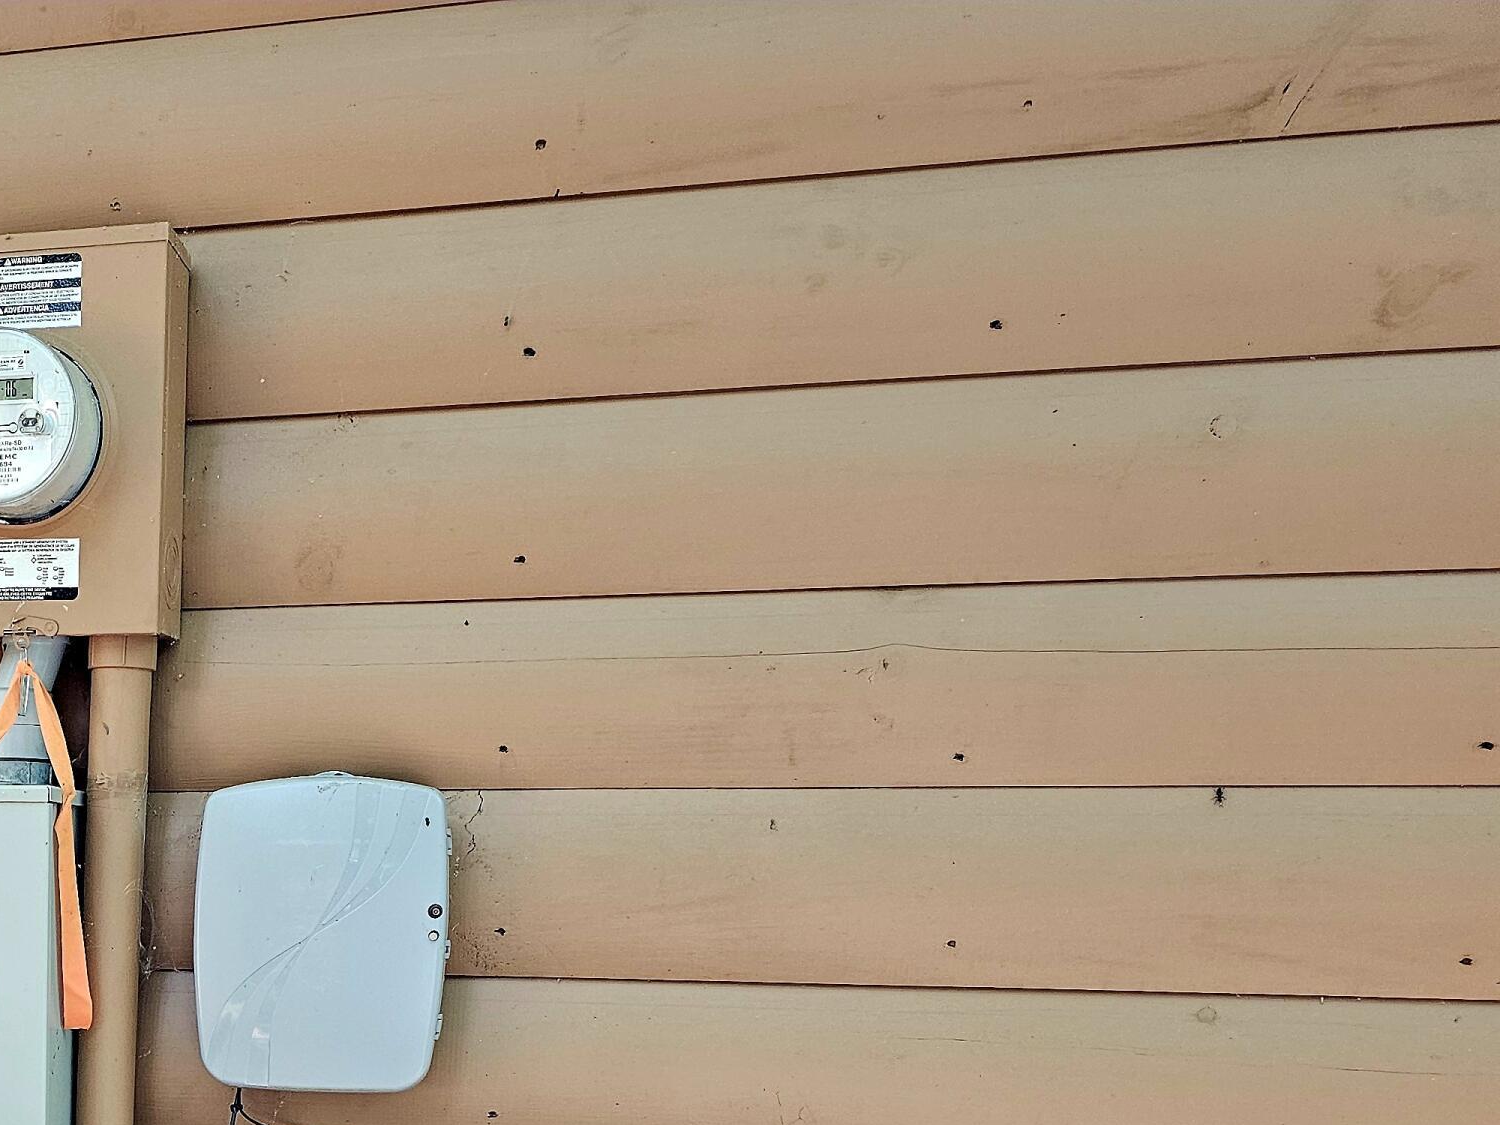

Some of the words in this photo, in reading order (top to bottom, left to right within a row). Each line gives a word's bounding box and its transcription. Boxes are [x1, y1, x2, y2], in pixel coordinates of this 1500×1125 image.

[11, 256, 43, 265] WARNING
[0, 280, 54, 291] AVERTISSEMENT
[3, 304, 50, 315] ADVERTENCIA
